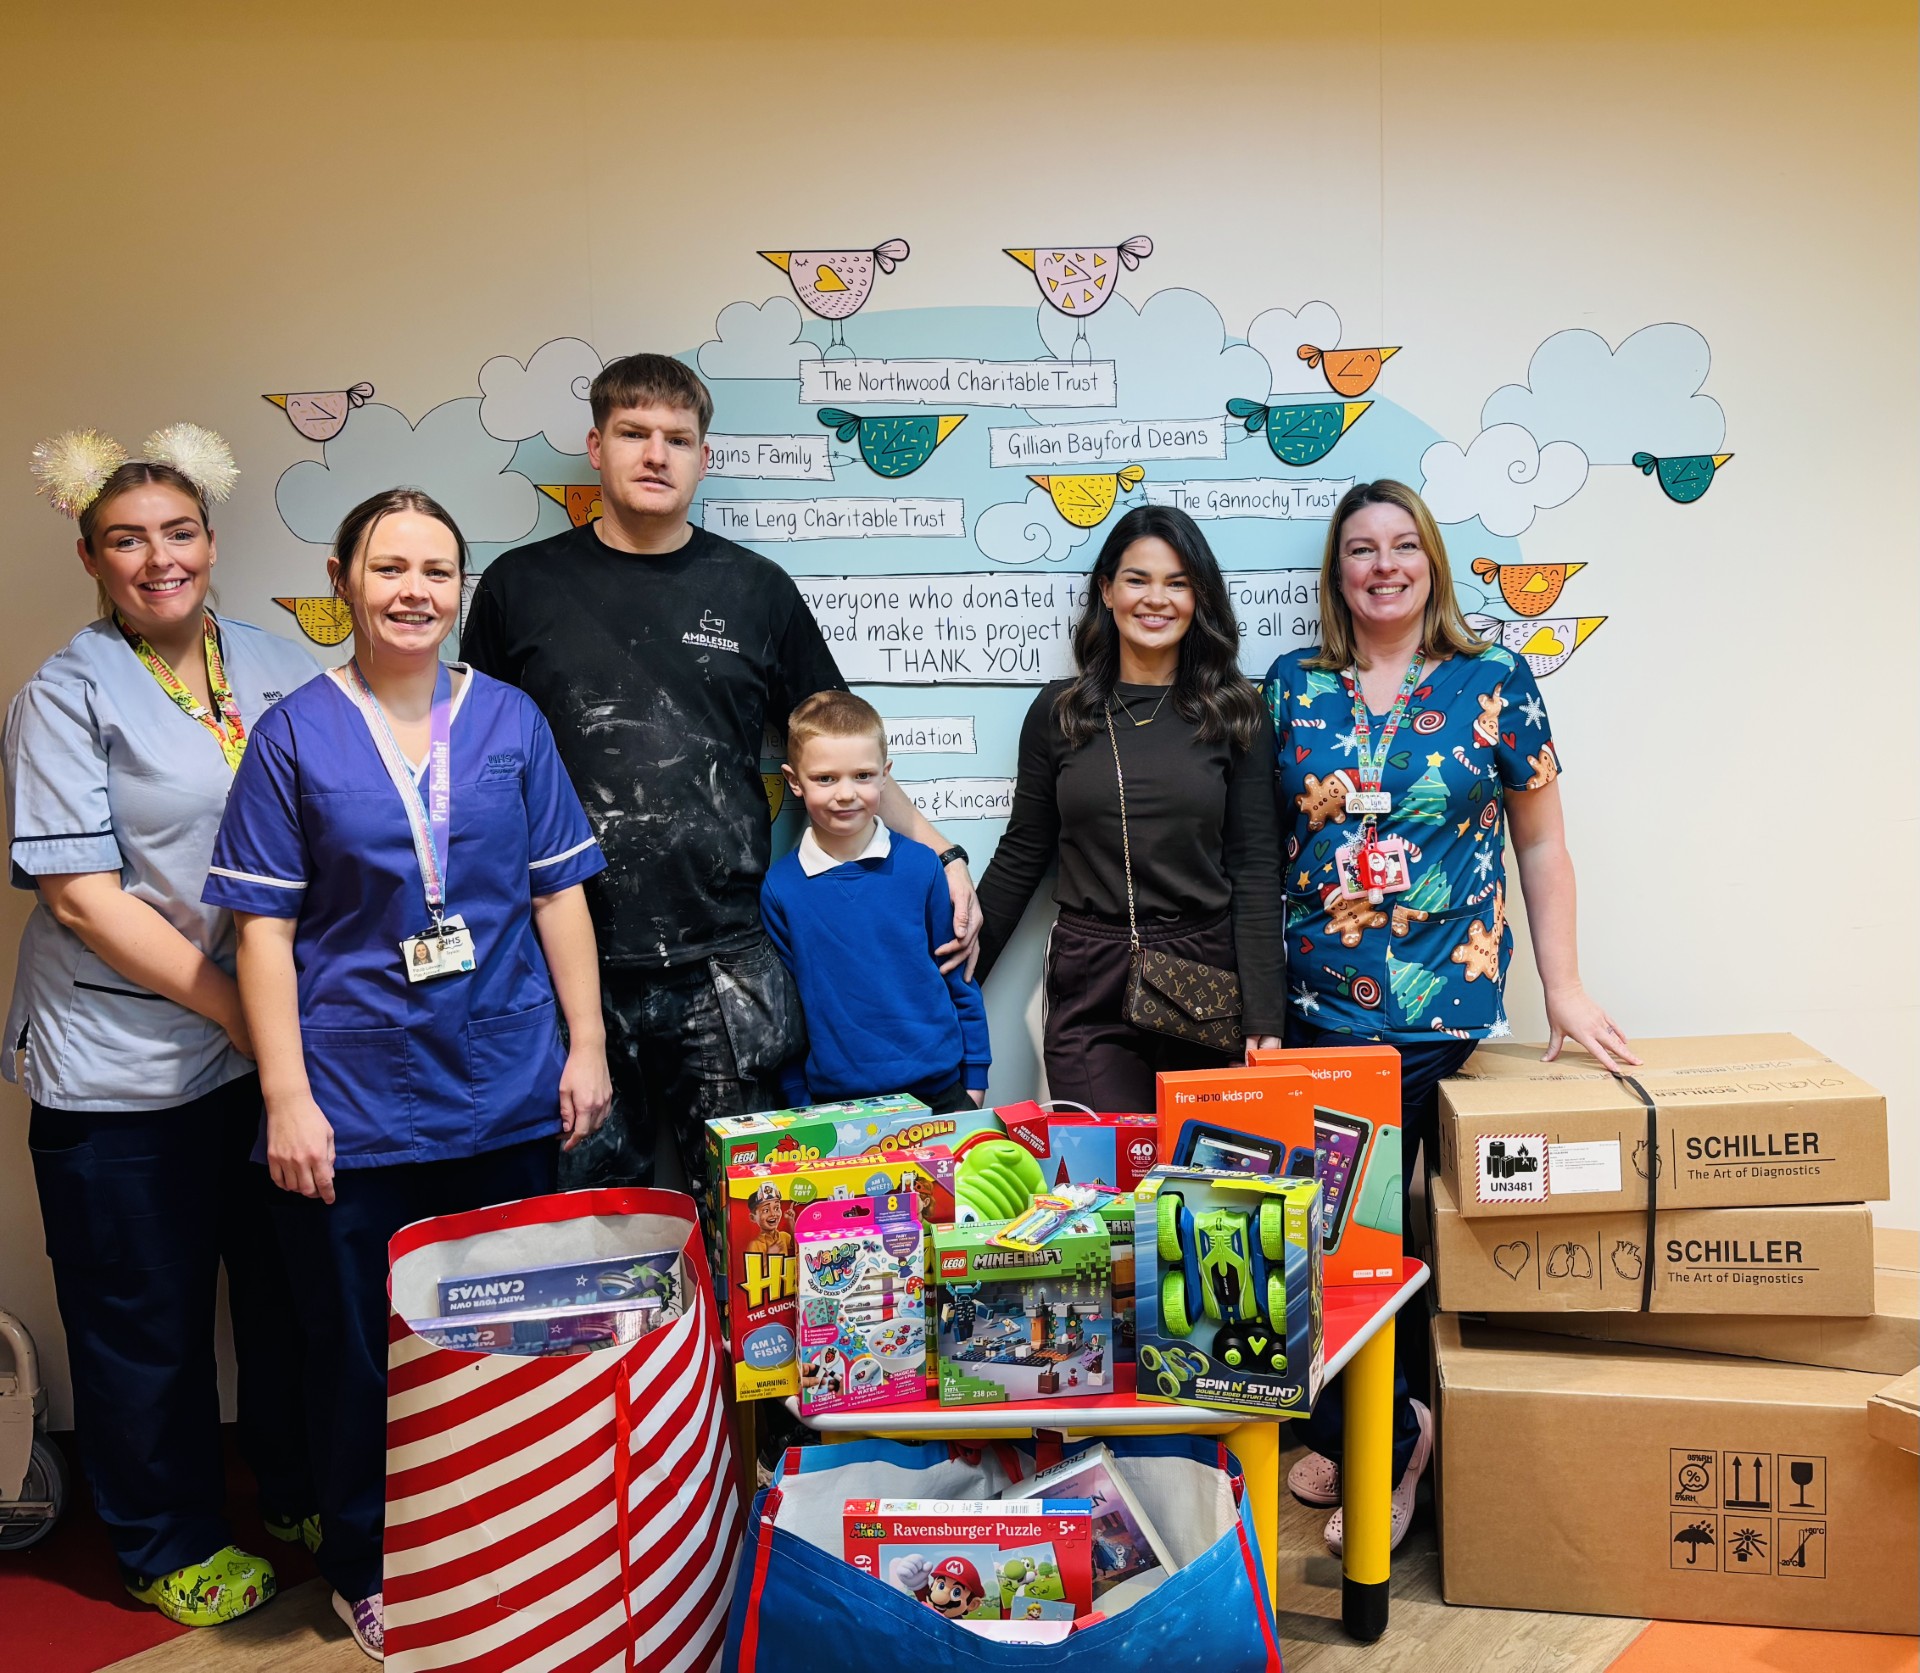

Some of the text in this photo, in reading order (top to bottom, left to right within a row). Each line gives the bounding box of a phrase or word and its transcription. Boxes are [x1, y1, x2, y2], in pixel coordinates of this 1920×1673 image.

[819, 368, 1098, 391] The Northwood Charitable Trust
[1008, 425, 1209, 459] Gillian Bayford Deans
[758, 444, 812, 472] Family
[1169, 487, 1337, 516] The Gannochy Trust
[716, 507, 946, 535] The Leng Charitable Trust
[801, 591, 899, 620] everyone
[909, 585, 953, 609] who
[963, 583, 1055, 609] donated
[1066, 583, 1090, 607] to
[867, 617, 924, 642] make
[934, 616, 977, 642] this
[987, 615, 1062, 648] project
[1258, 612, 1281, 636] all
[682, 631, 739, 649] AMBLESIDE
[879, 647, 1040, 673] THANK YOU!
[262, 691, 283, 699] NHS
[487, 754, 512, 763] NHS
[431, 740, 449, 822] Play Specialist
[945, 788, 1012, 808] Kincard
[1312, 1069, 1352, 1081] kids pro
[1175, 1089, 1264, 1104] fire HD 10 kids pro
[1656, 1087, 1738, 1098] SCHILLER
[1130, 1143, 1154, 1156] 40
[1686, 1132, 1820, 1160] SCHILLER
[733, 1151, 756, 1164] LEGO
[1688, 1164, 1821, 1180] The Art of Diagnostics
[1490, 1182, 1533, 1192] UN3481
[887, 1195, 898, 1211] 8
[804, 1242, 860, 1273] Water
[973, 1247, 1063, 1270] MINECRAFT
[1666, 1239, 1803, 1263] SCHILLER
[942, 1258, 966, 1270] LEGO
[819, 1260, 853, 1287] Art
[1668, 1272, 1804, 1286] The Art of Diagnostics
[448, 1279, 525, 1302] CANVAS
[449, 1294, 526, 1311] PAINT YOUR OWN
[747, 1309, 767, 1322] THE
[751, 1334, 787, 1351] AM I A
[754, 1343, 788, 1359] FISH?
[756, 1379, 789, 1388] WARNING:
[943, 1377, 957, 1387] 7+
[1195, 1377, 1230, 1391] SPIN
[1247, 1383, 1296, 1398] STUNT
[972, 1390, 998, 1398] 238 pcs
[1195, 1388, 1222, 1396] DOUBLE
[1034, 1451, 1087, 1482] FROZEN
[849, 1528, 887, 1539] MARIO
[854, 1522, 883, 1531] SUPER
[893, 1522, 1042, 1540] Ravensburger Puzzle
[1058, 1520, 1076, 1535] 5+
